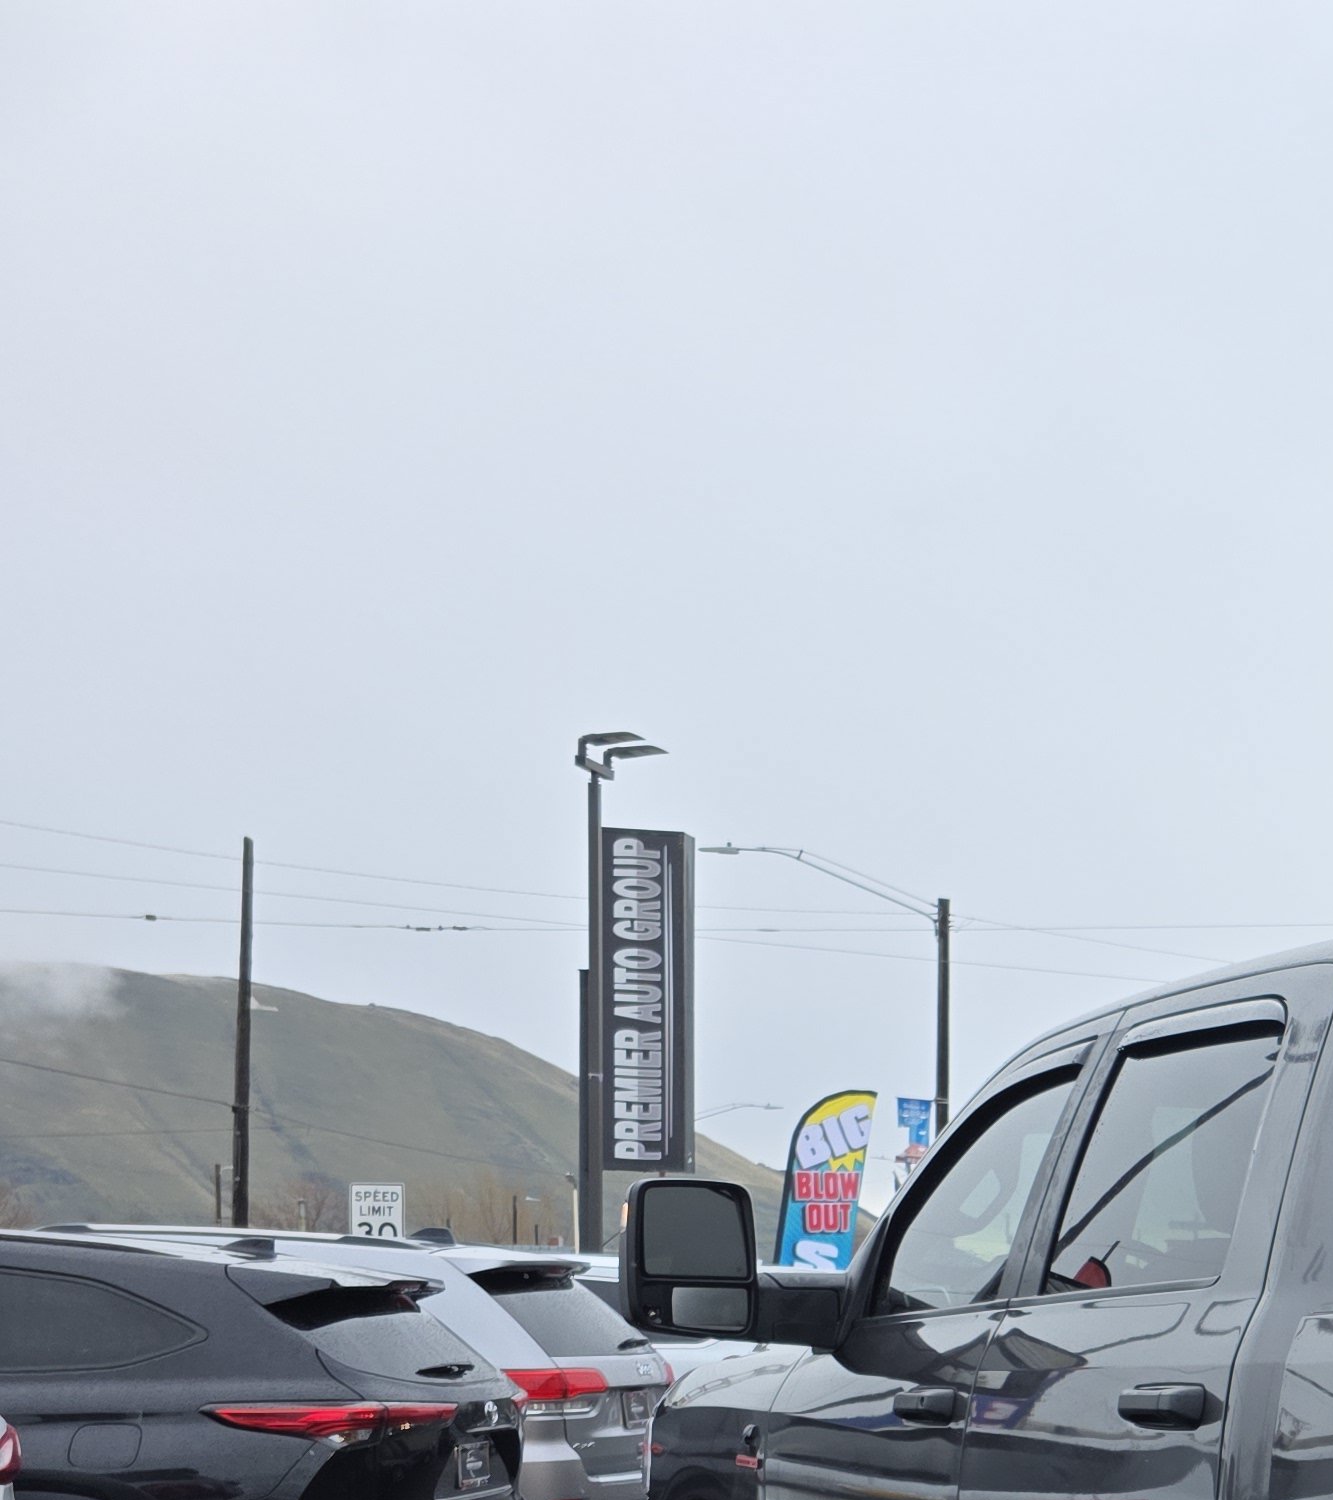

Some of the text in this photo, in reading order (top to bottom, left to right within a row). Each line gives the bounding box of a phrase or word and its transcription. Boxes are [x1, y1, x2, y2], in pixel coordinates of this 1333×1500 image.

[612, 837, 662, 1161] PREMIER AUTO GROUP
[795, 1104, 872, 1169] BIG
[355, 1191, 400, 1203] SPEED
[794, 1170, 860, 1201] BLOW
[359, 1205, 394, 1217] LIMIT
[805, 1202, 852, 1233] OUT
